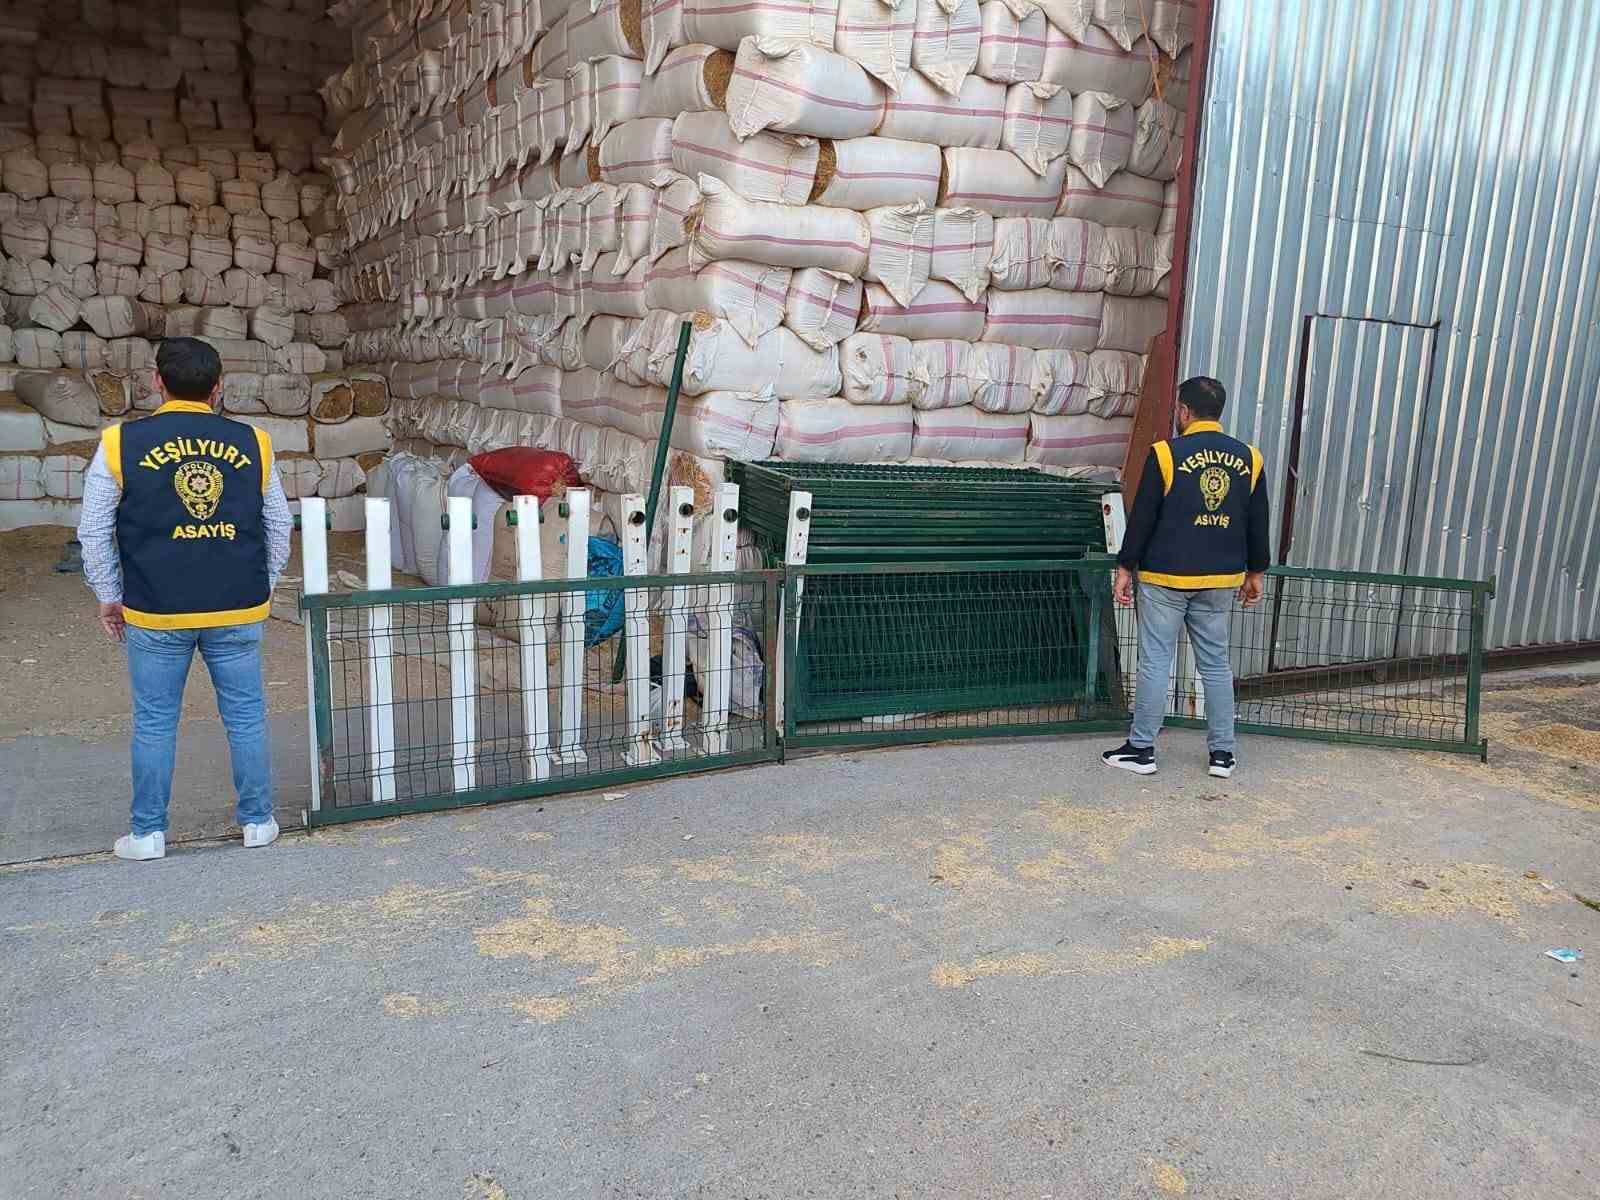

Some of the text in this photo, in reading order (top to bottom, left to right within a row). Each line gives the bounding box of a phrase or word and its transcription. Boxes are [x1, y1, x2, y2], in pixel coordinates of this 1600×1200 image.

[139, 437, 251, 470] YEŞİLYURT
[1178, 448, 1250, 476] YEŞİLYURT
[172, 521, 236, 540] ASAYİŞ
